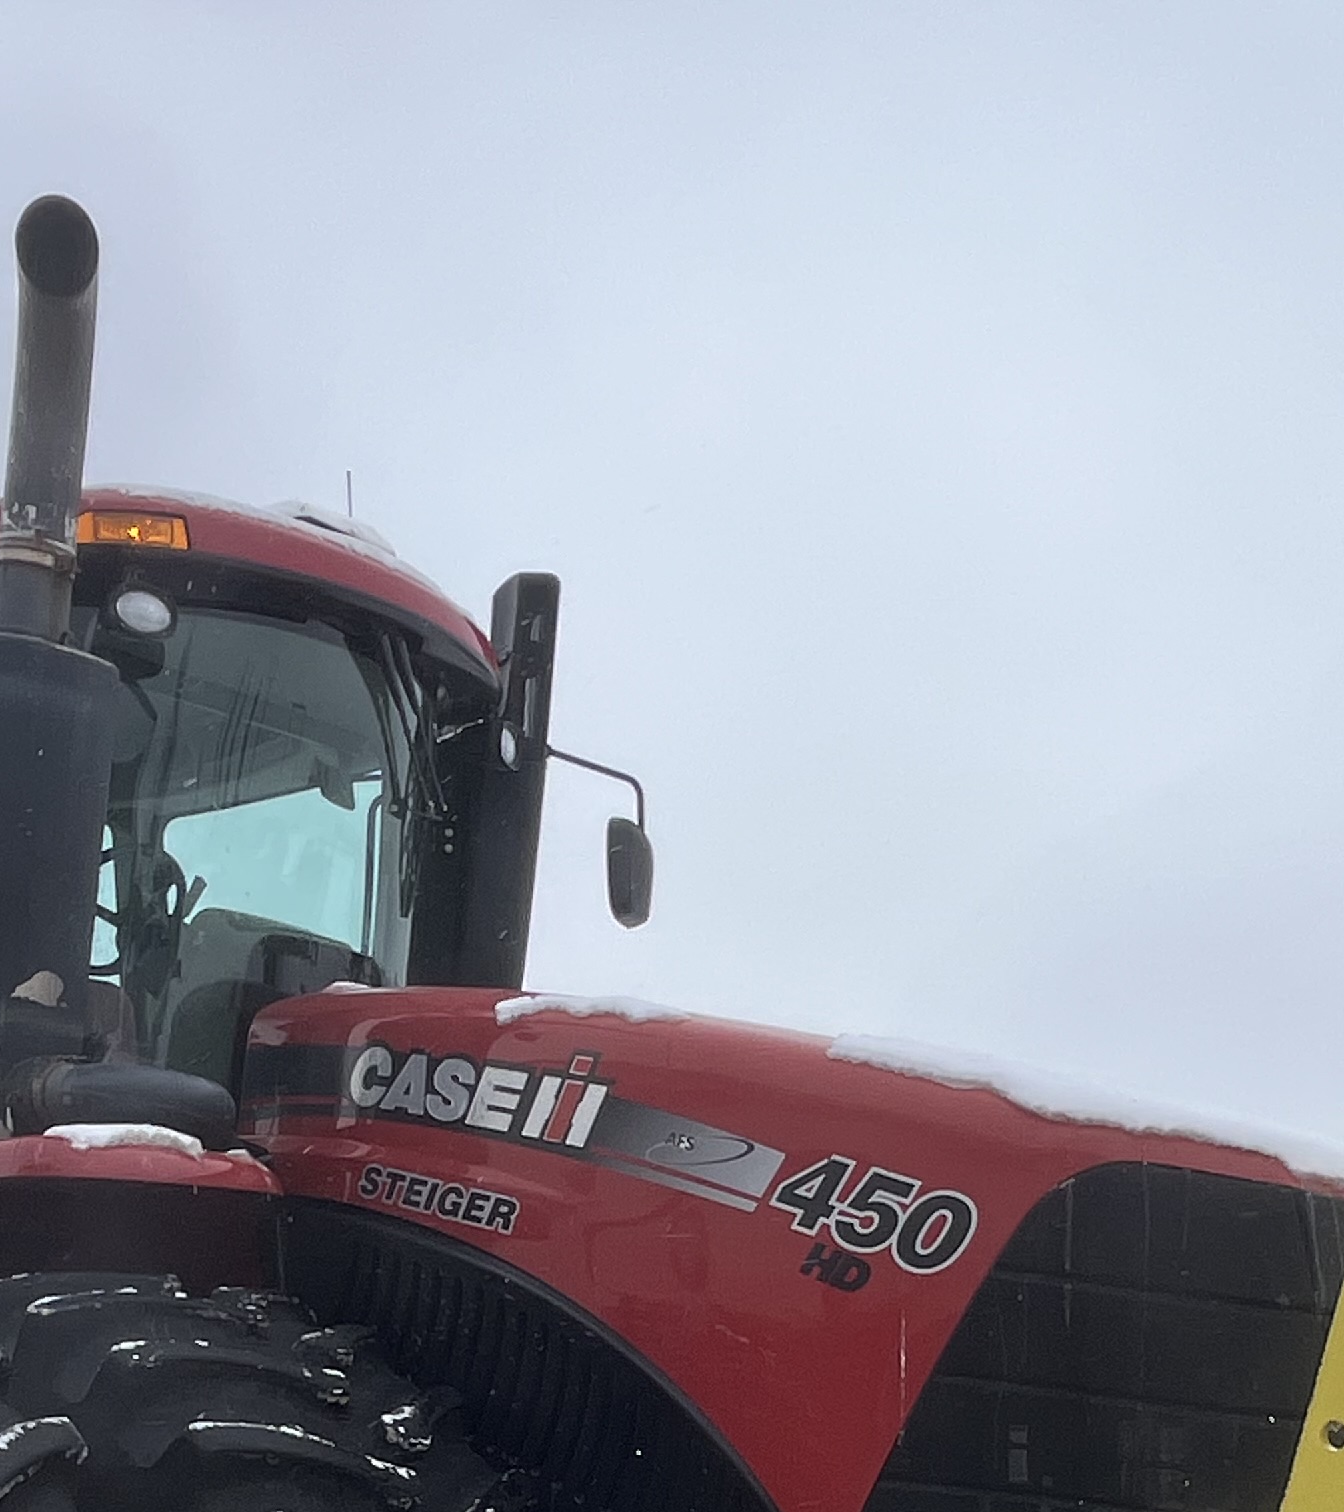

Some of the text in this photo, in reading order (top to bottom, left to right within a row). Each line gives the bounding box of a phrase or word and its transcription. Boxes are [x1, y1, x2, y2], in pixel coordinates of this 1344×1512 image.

[350, 1045, 530, 1133] CASE
[664, 1131, 696, 1152] AFS
[358, 1163, 520, 1236] STEIGER
[768, 1153, 979, 1276] 450
[799, 1242, 873, 1293] HD
